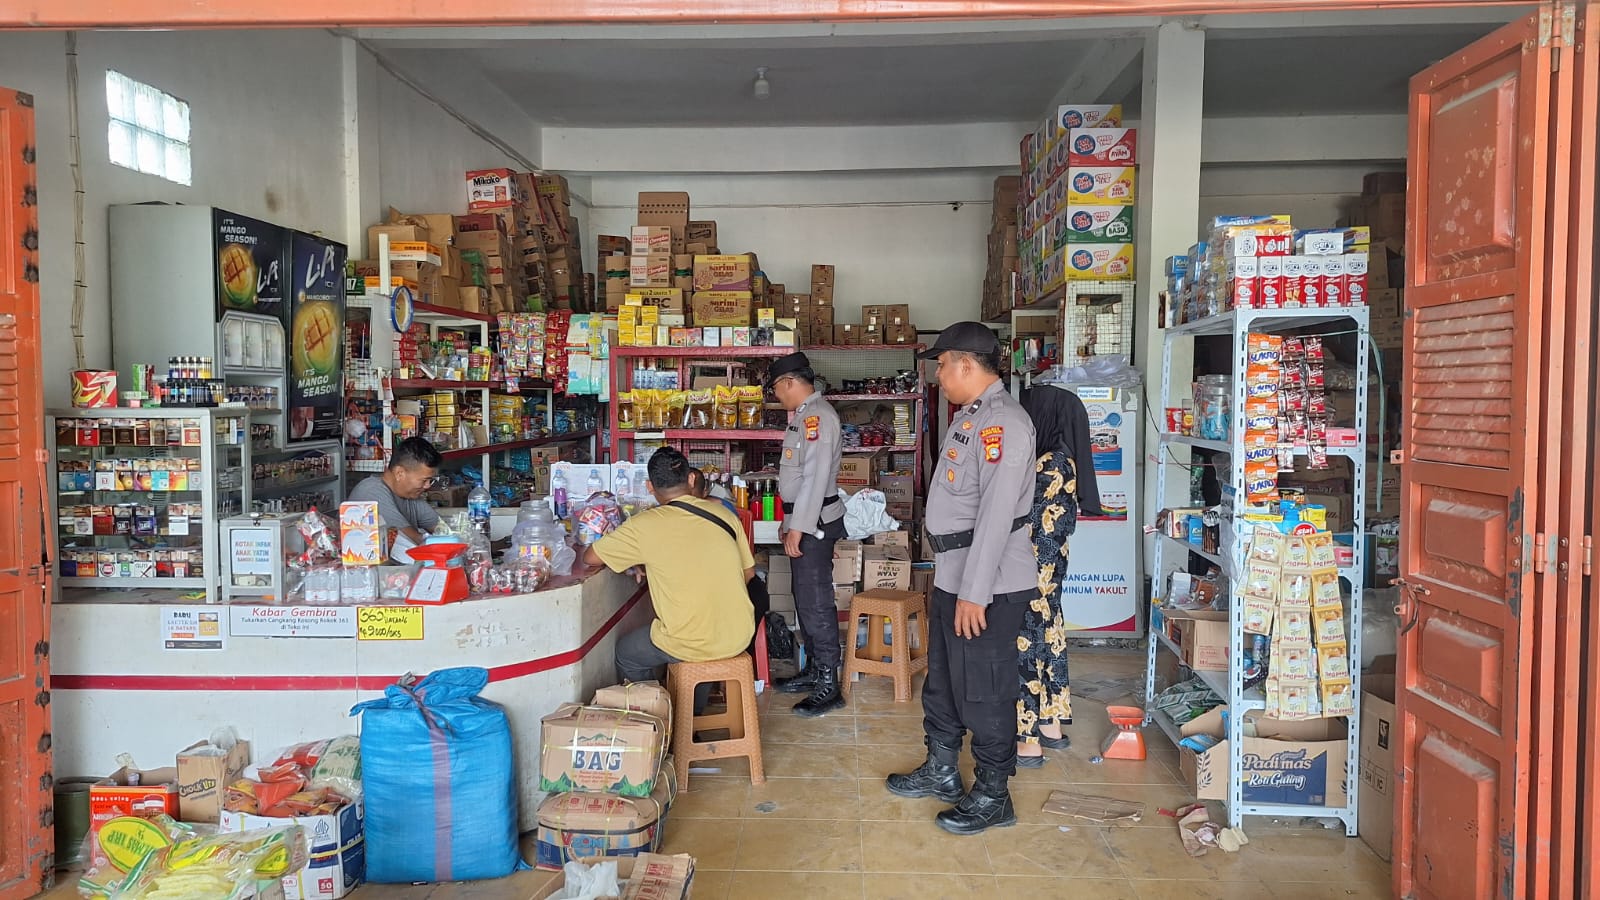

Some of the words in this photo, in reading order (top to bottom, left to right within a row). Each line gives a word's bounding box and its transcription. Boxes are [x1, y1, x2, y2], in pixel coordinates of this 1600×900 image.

[472, 175, 501, 187] Mikako
[220, 226, 247, 234] MANGO
[225, 235, 257, 245] SEASON!
[1250, 351, 1279, 362] SUKRO
[298, 375, 329, 388] MANGO
[952, 431, 970, 445] POLRI
[1246, 448, 1274, 460] SUKRO
[1249, 480, 1275, 492] SUKRO
[1102, 574, 1125, 582] LUPA
[1062, 586, 1092, 594] MINUM
[1095, 586, 1128, 595] YAKULT
[252, 607, 286, 617] Kabar
[291, 607, 337, 617] Gembira
[573, 750, 622, 771] BAG
[1249, 772, 1270, 787] Roti
[320, 882, 332, 890] 50
